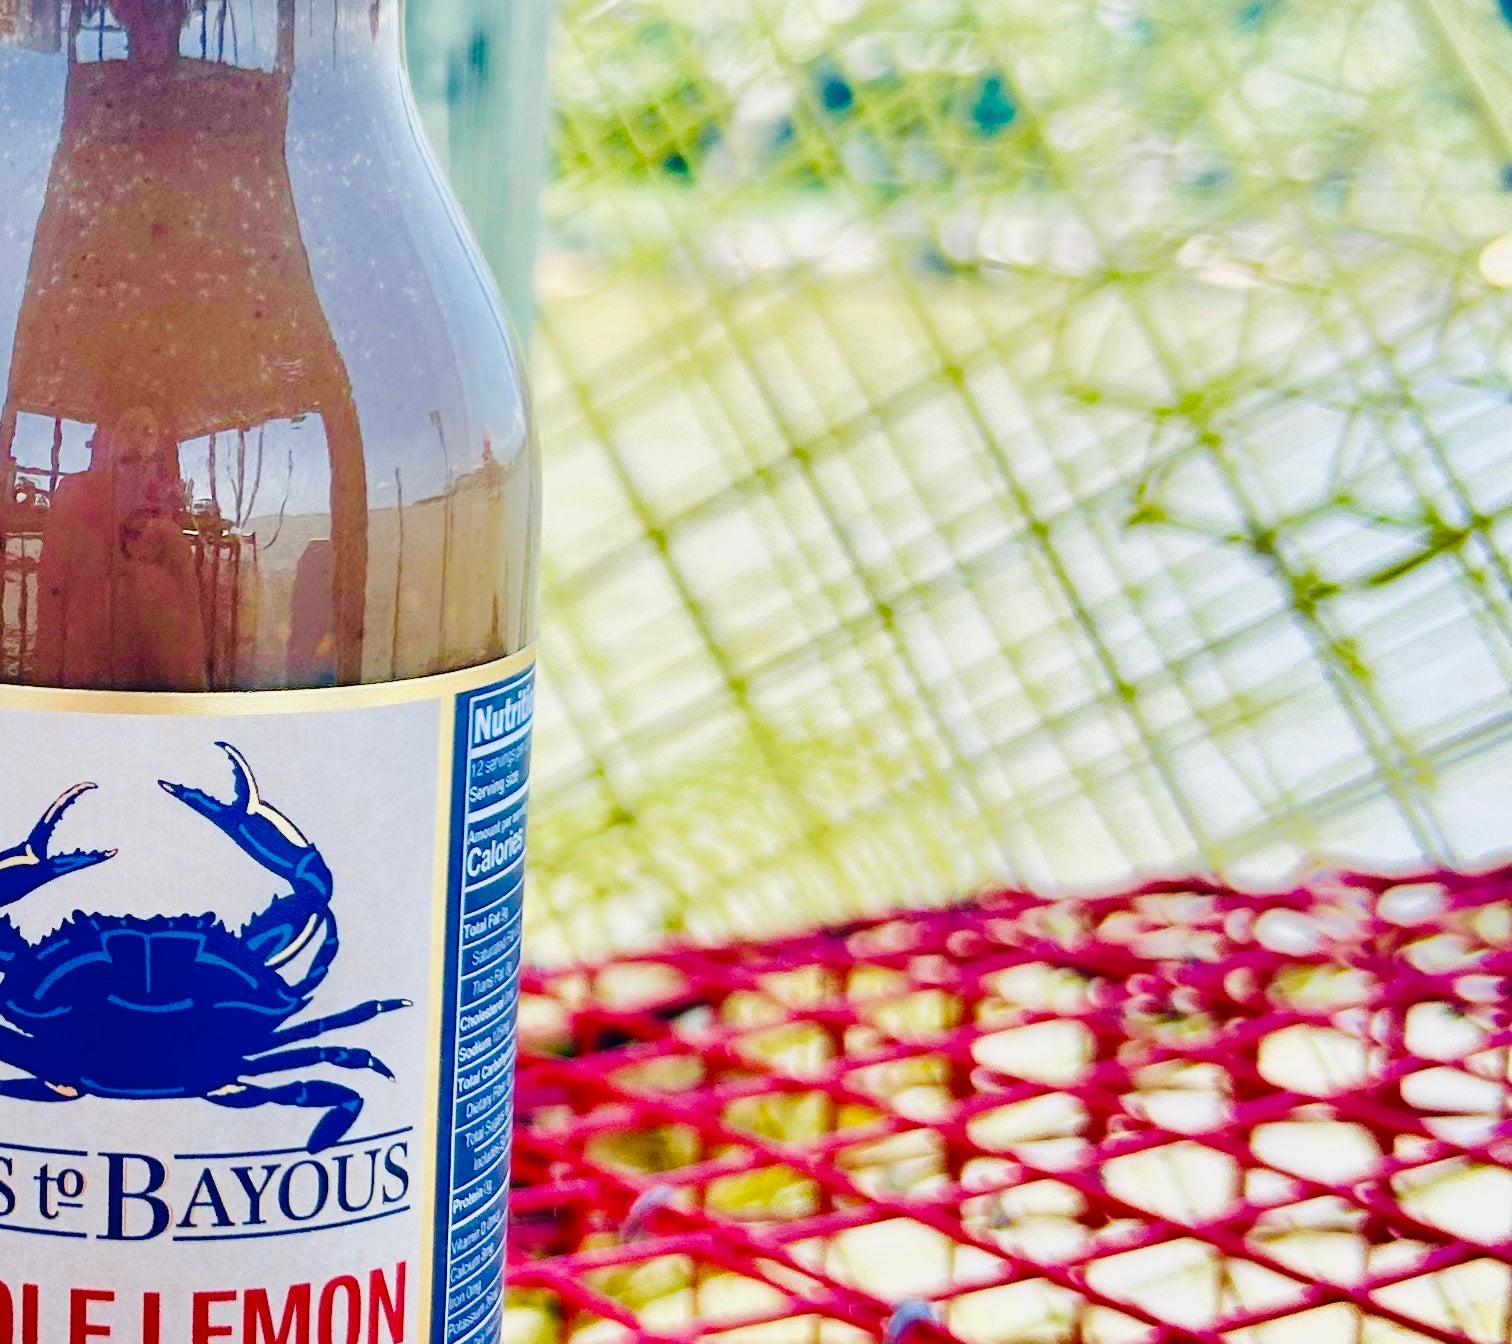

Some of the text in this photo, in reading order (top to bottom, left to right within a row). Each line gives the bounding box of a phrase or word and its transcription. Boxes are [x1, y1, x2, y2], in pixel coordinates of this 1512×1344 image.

[472, 759, 483, 777] 12
[469, 779, 505, 802] Serving
[468, 820, 500, 845] Amount
[467, 827, 523, 876] Calories
[464, 917, 487, 938] Total
[488, 911, 500, 928] Fat
[459, 1037, 492, 1062] Sodium
[457, 1070, 480, 1092] Total
[34, 1163, 85, 1219] to
[96, 1141, 409, 1241] BAYOUS
[453, 1187, 483, 1214] Protein
[452, 1229, 480, 1254] Vitamin
[451, 1255, 480, 1283] Calcium
[449, 1292, 465, 1311] Iron
